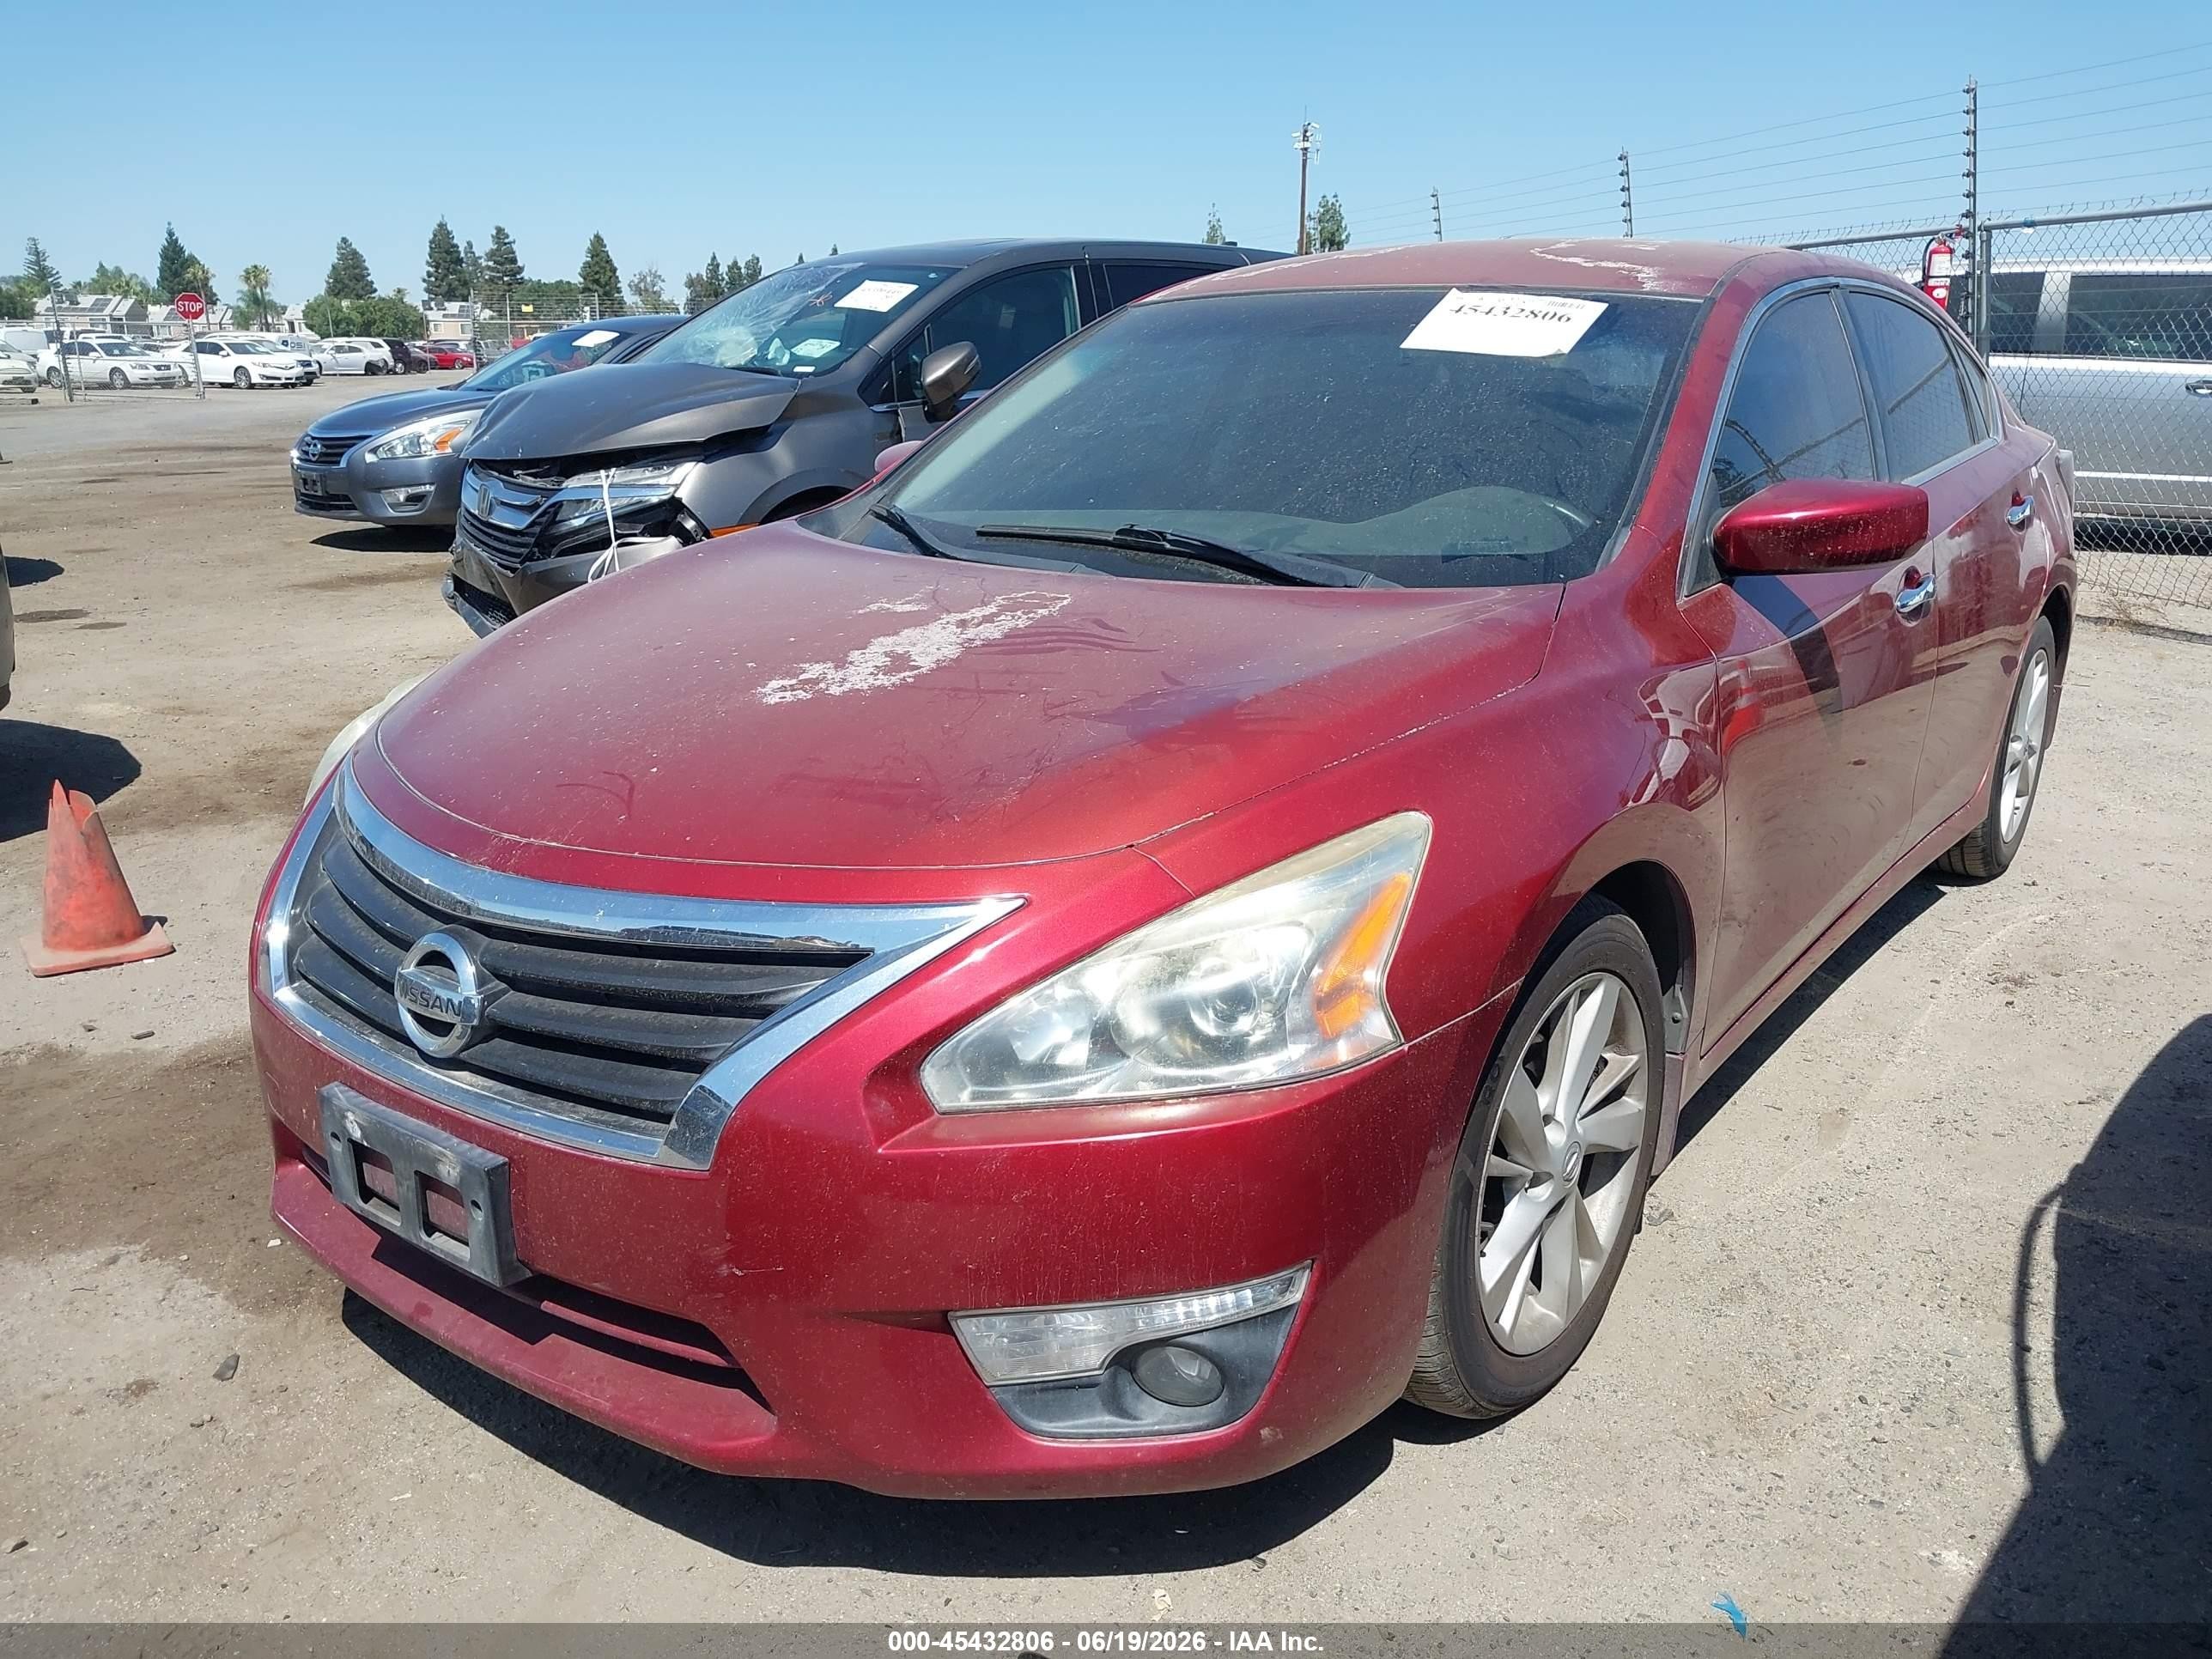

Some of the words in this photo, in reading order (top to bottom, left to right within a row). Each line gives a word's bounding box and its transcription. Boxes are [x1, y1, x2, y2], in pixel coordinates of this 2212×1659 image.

[178, 301, 203, 313] STOP
[1449, 304, 1572, 324] 45432806
[397, 976, 463, 1018] NISSAN
